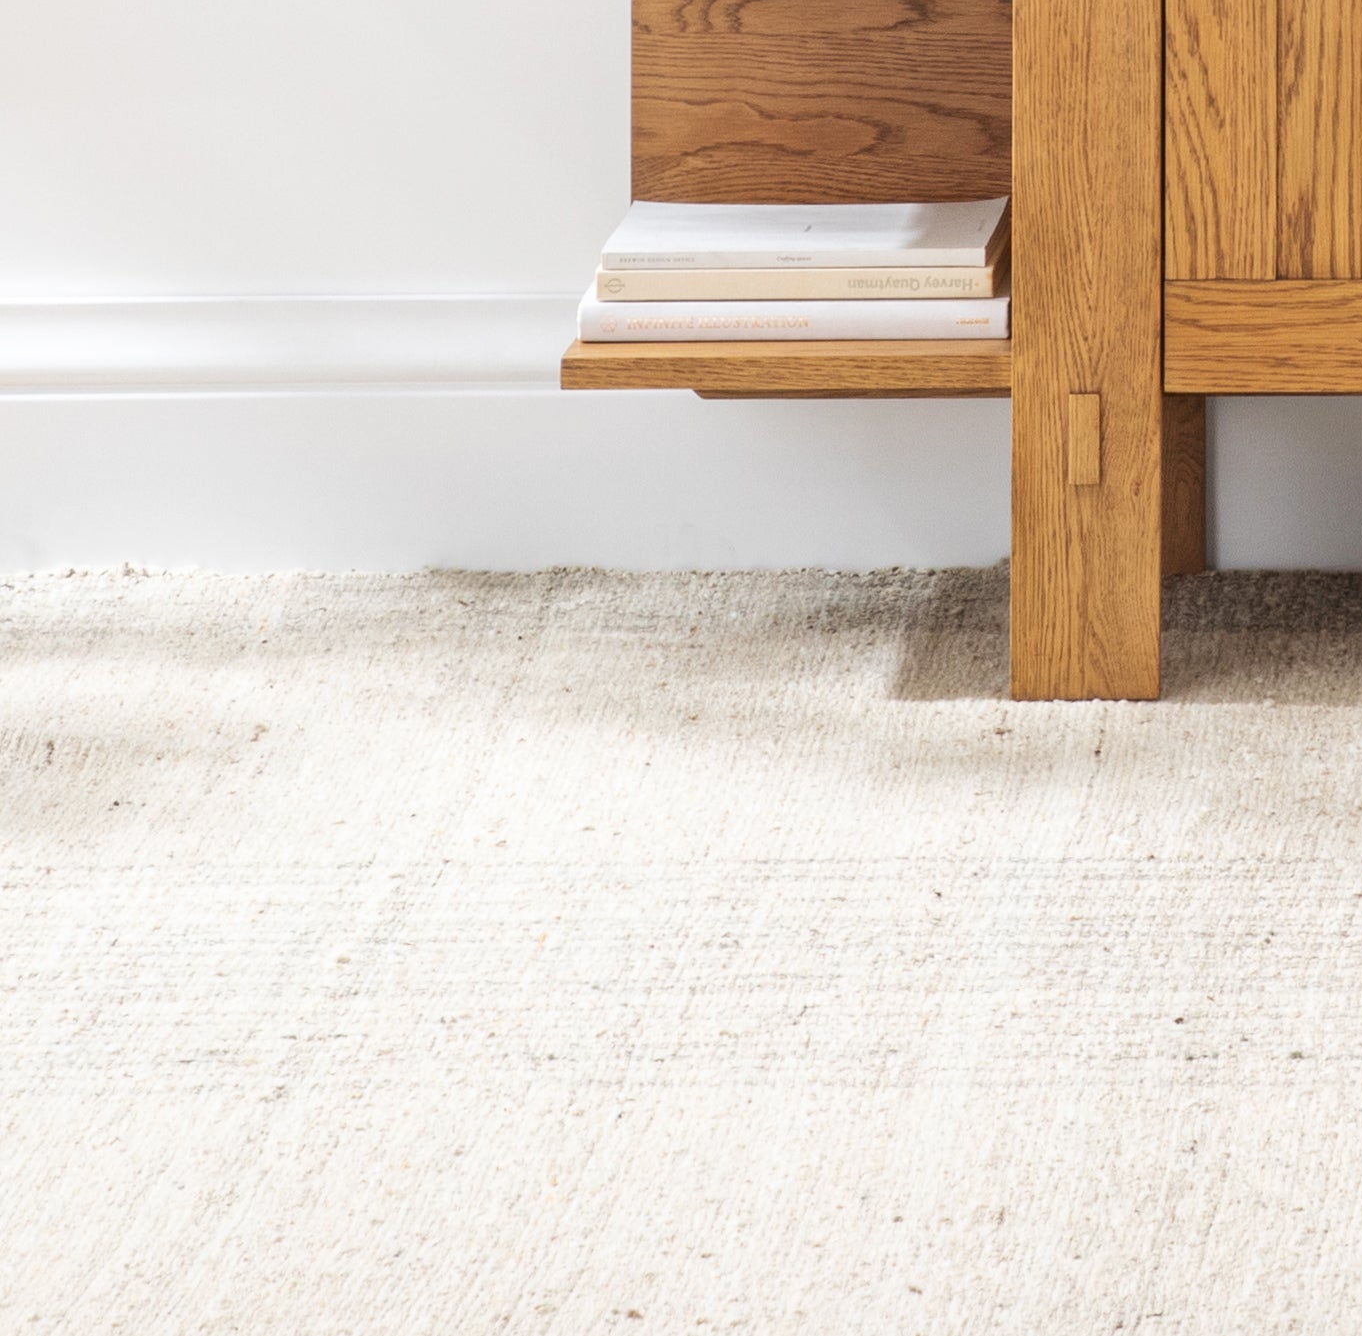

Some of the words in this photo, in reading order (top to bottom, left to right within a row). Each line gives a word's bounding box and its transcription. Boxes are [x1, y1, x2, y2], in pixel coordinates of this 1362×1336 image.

[848, 277, 920, 291] Quaytman
[925, 276, 973, 290] Harvey
[627, 317, 695, 330] INFINITE
[699, 315, 810, 328] ILLUSTRATION
